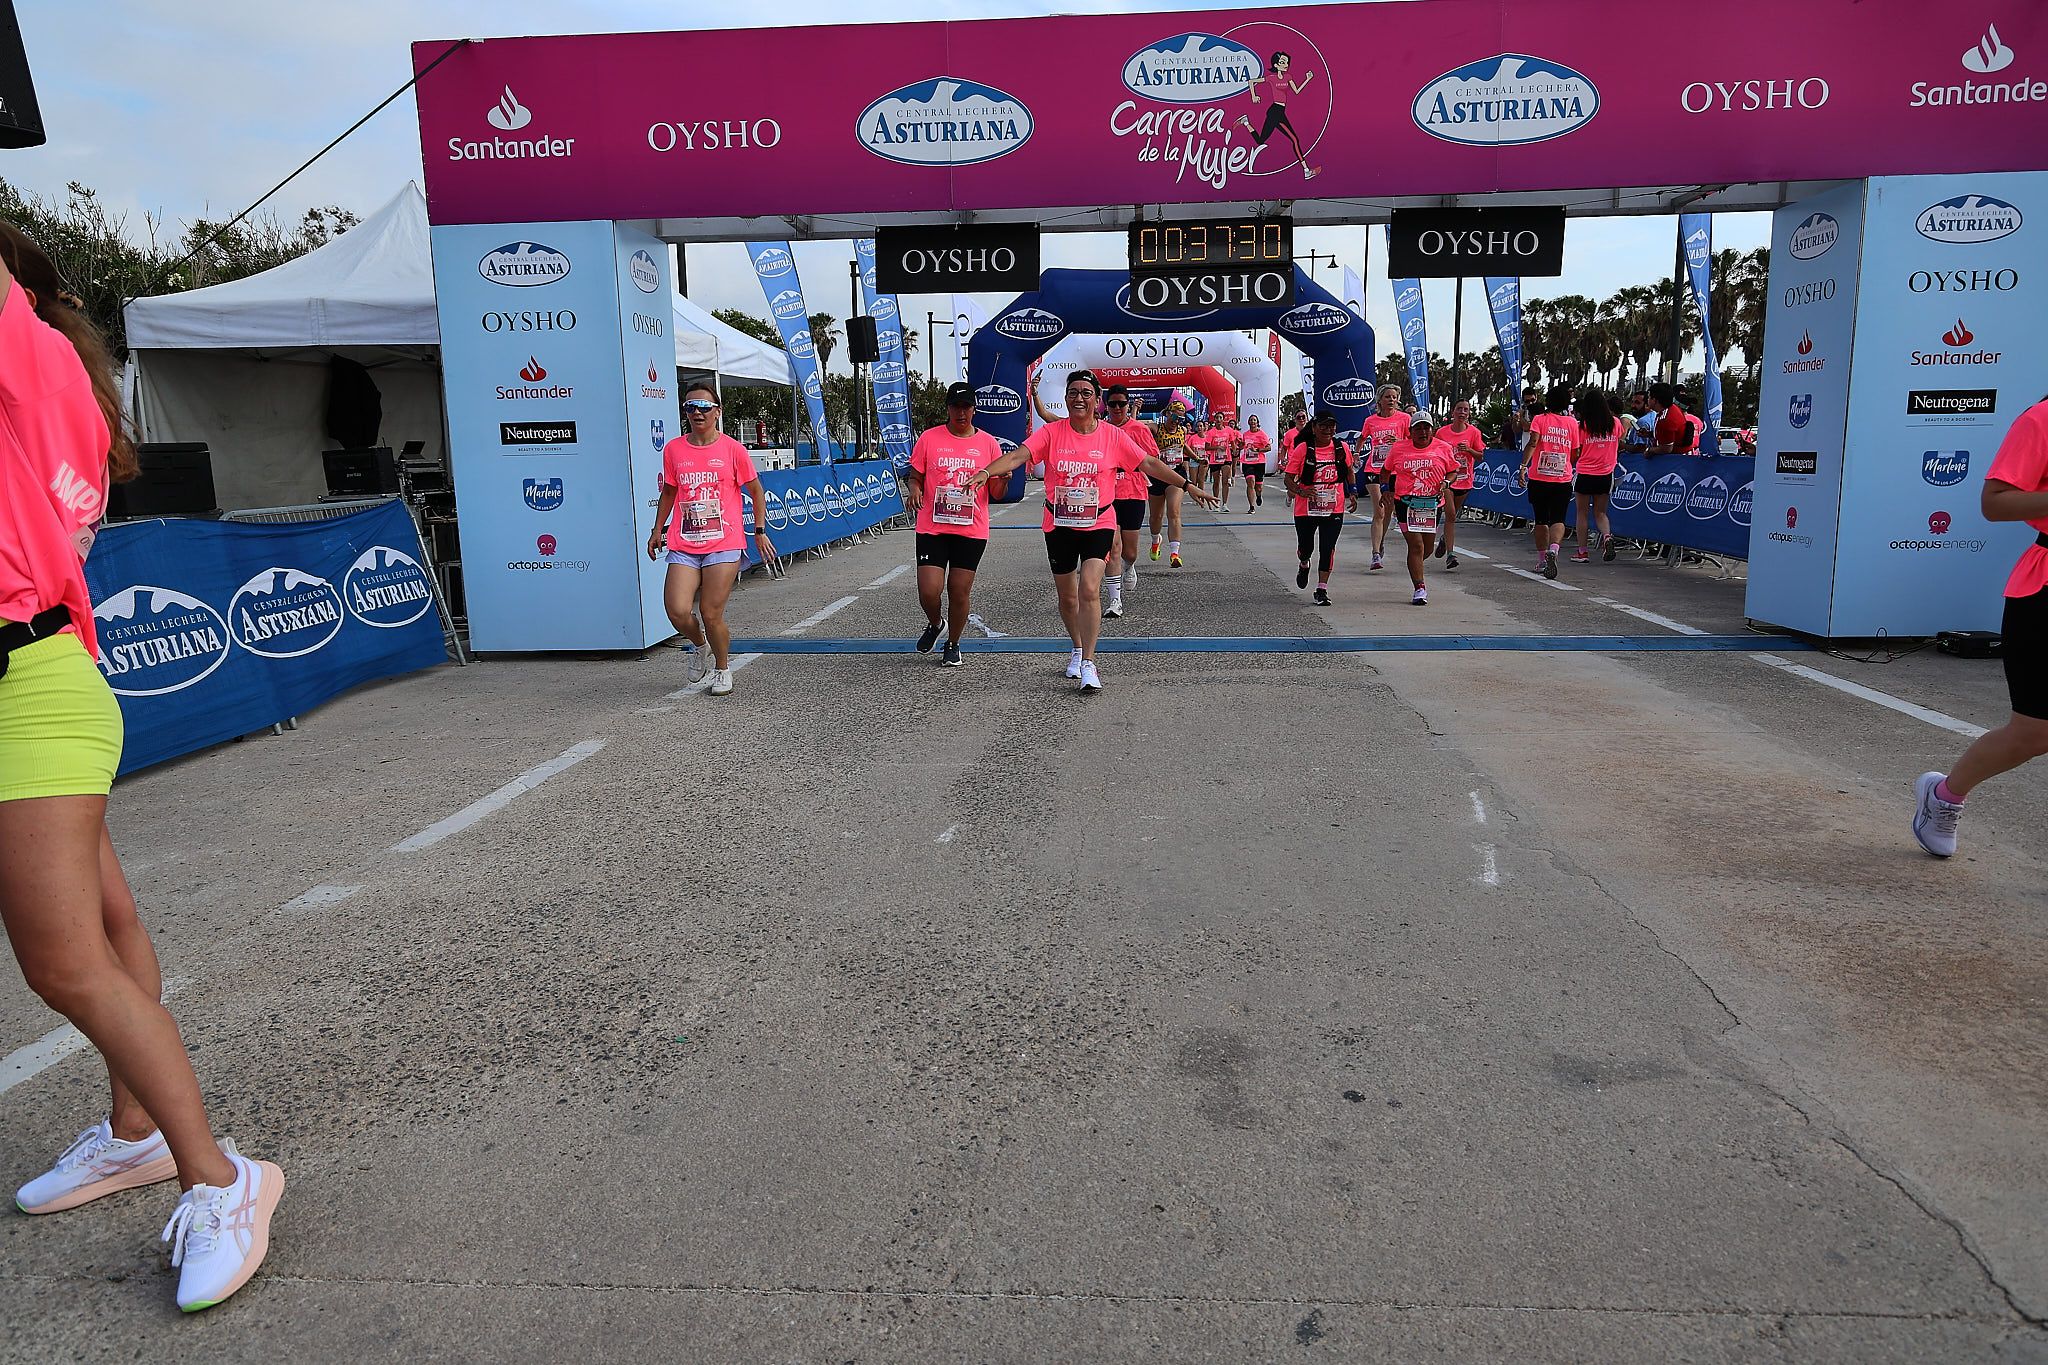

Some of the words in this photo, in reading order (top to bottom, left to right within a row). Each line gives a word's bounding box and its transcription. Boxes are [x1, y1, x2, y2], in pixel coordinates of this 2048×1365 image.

[1154, 56, 1198, 66] CENTRAL
[1201, 54, 1248, 65] LECHERA
[1134, 60, 1253, 88] ASTURIANA
[1456, 86, 1514, 97] CENTRAL
[1518, 83, 1580, 95] LECHERA
[1681, 77, 1829, 113] OYSHO
[1909, 77, 2048, 107] Santande
[896, 107, 951, 118] CENTRAL
[956, 104, 1014, 116] LECHERA
[1426, 91, 1585, 126] ASTURIANA
[1109, 100, 1226, 137] Carrera
[647, 117, 782, 153] OYSHO
[870, 111, 1020, 146] ASTURIANA
[448, 135, 575, 161] Santander
[1138, 136, 1160, 162] de
[1163, 137, 1180, 162] la
[1176, 130, 1267, 190] Mujer
[1923, 213, 2014, 233] ASTURIANA
[1418, 230, 1540, 257] OYSHO
[1792, 229, 1835, 253] ASTURIANA
[486, 259, 565, 277] ASTURIANA
[902, 247, 1015, 274] OYSHO
[632, 267, 658, 286] ASTURIANA
[1908, 268, 2019, 293] OYSHO
[1137, 272, 1287, 307] OYSHO
[1784, 278, 1837, 308] OYSHO
[481, 310, 577, 332] OYSHO
[632, 313, 663, 338] OYSHO
[1000, 319, 1058, 333] ASTURIANA
[1284, 315, 1346, 329] ASTURIANA
[1105, 336, 1204, 359] OYSHO
[1231, 357, 1262, 365] OYSHO
[1783, 357, 1825, 374] Santander
[1911, 350, 2002, 366] Santander
[1101, 368, 1129, 377] Sports
[1142, 366, 1187, 376] Santander
[496, 385, 574, 400] Santander
[641, 385, 666, 400] Santander
[1246, 397, 1275, 405] OYSHO
[1327, 389, 1373, 401] ASTURIANA
[1913, 395, 1989, 411] Neutrogena
[505, 426, 571, 442] Neutrogena
[1547, 426, 1569, 437] SOMOS
[938, 458, 976, 470] CARRERA
[1057, 460, 1098, 474] CARRERA
[1403, 459, 1433, 469] CARRERA
[1779, 456, 1814, 472] Neutrogena
[1925, 458, 1966, 477] Marlene
[680, 471, 719, 485] CARRERA
[525, 485, 562, 503] Marlene
[1647, 486, 1682, 505] ASTURIANA
[1687, 490, 1724, 510] ASTURIANA
[946, 503, 962, 511] 016
[1067, 505, 1085, 513] 016
[361, 573, 390, 586] CENTRAL
[391, 569, 419, 582] LECHERA
[253, 596, 292, 612] CENTRAL
[353, 578, 428, 613] ASTURIANA
[107, 623, 159, 641] CENTRAL
[161, 612, 209, 632] LECHERA
[242, 602, 340, 644] ASTURIANA
